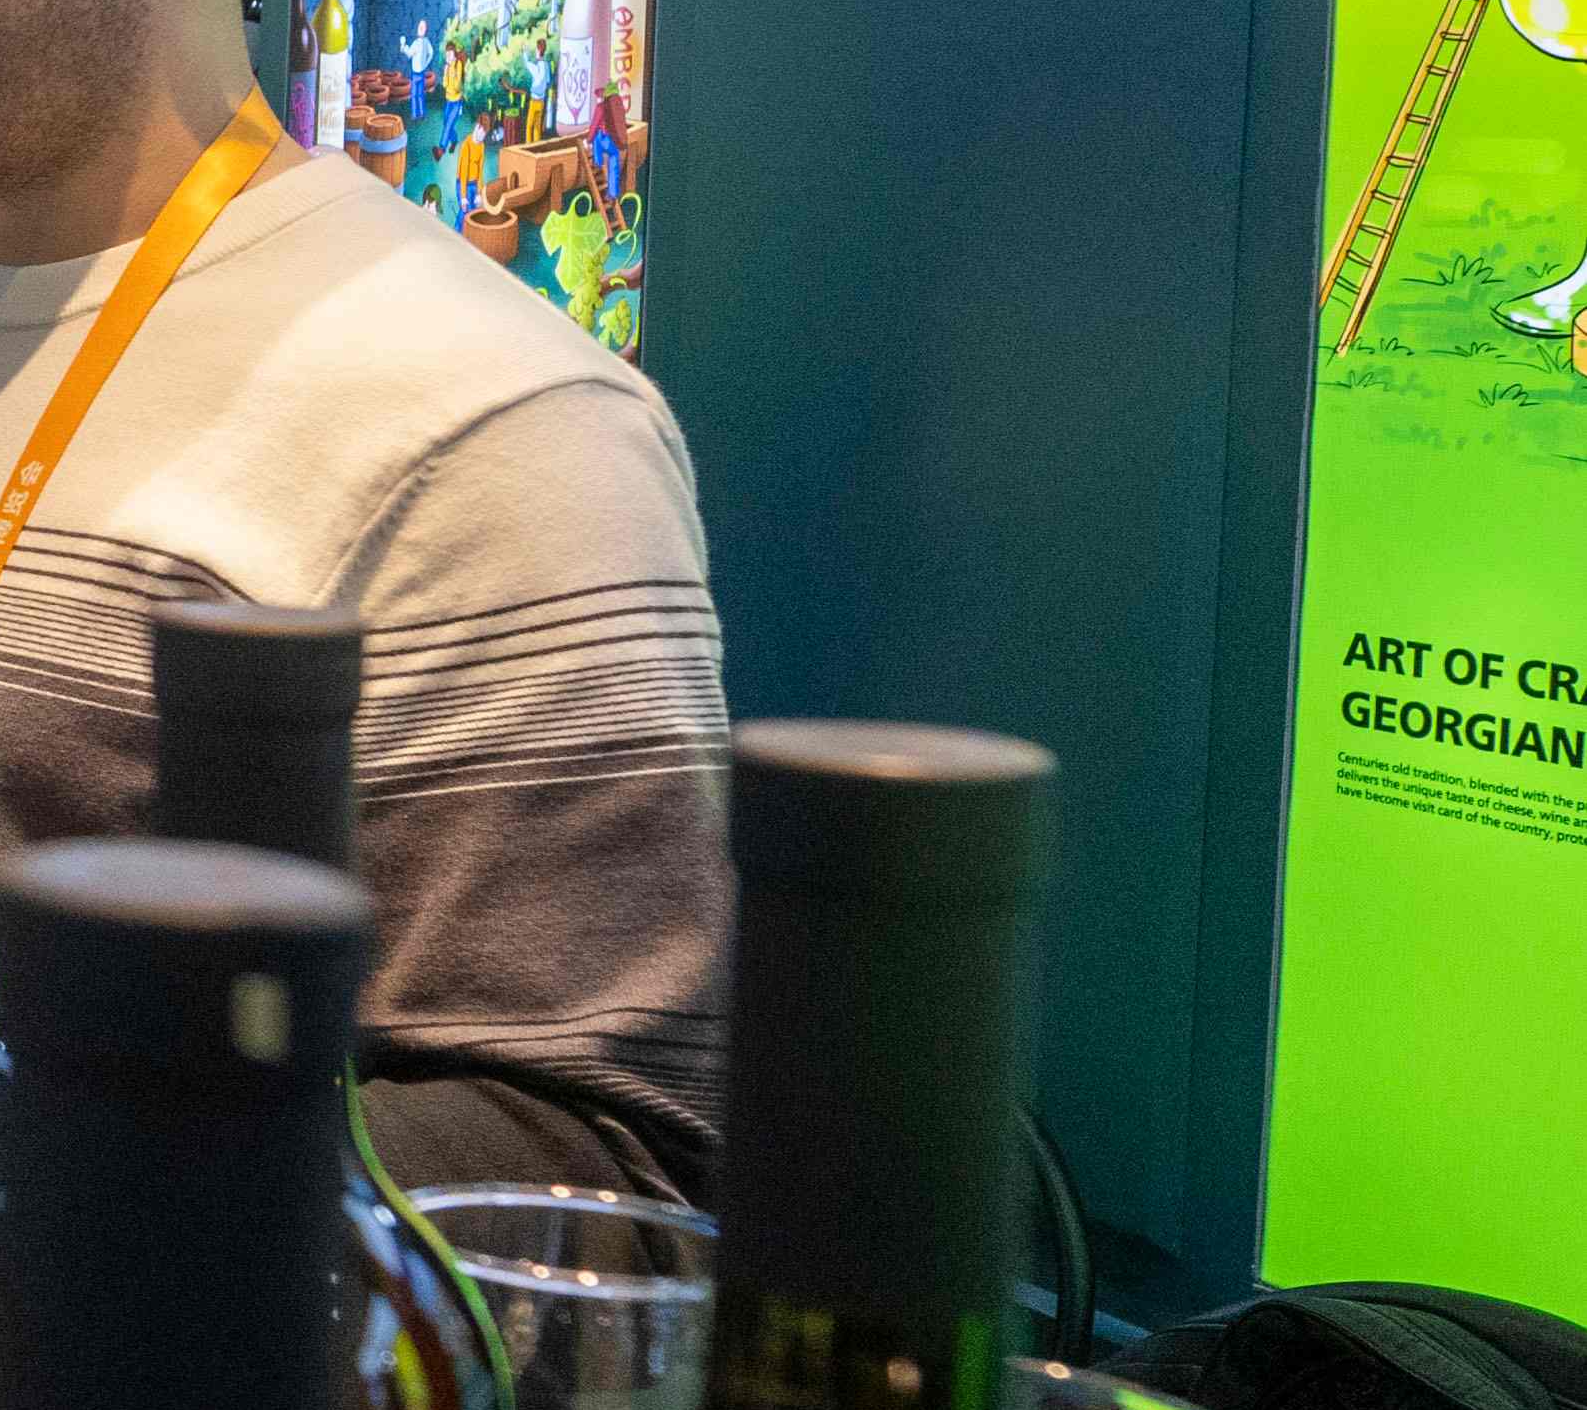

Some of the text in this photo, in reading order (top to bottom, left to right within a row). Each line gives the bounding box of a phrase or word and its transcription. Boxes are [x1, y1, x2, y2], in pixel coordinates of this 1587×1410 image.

[1342, 632, 1433, 679] ART
[1443, 648, 1505, 690] OF
[1341, 691, 1587, 769] GEORGIAN
[1336, 768, 1379, 786] delivers
[1381, 776, 1400, 789] the
[1402, 782, 1443, 801] unique
[1446, 790, 1474, 806] taste
[1477, 795, 1491, 808] of
[1492, 799, 1537, 820] cheese,
[1539, 809, 1571, 826] wine
[1337, 751, 1389, 772] Centuries
[1391, 762, 1410, 777] old
[1413, 767, 1466, 788] tradition,
[1469, 777, 1520, 797] blended
[1522, 788, 1550, 804] with
[1553, 795, 1575, 808] the
[1336, 782, 1363, 799] have
[1365, 789, 1410, 809] become
[1412, 799, 1436, 814] visit
[1437, 804, 1463, 820] card
[1465, 810, 1480, 823] of
[1481, 814, 1502, 829] the
[1503, 818, 1554, 841] country,
